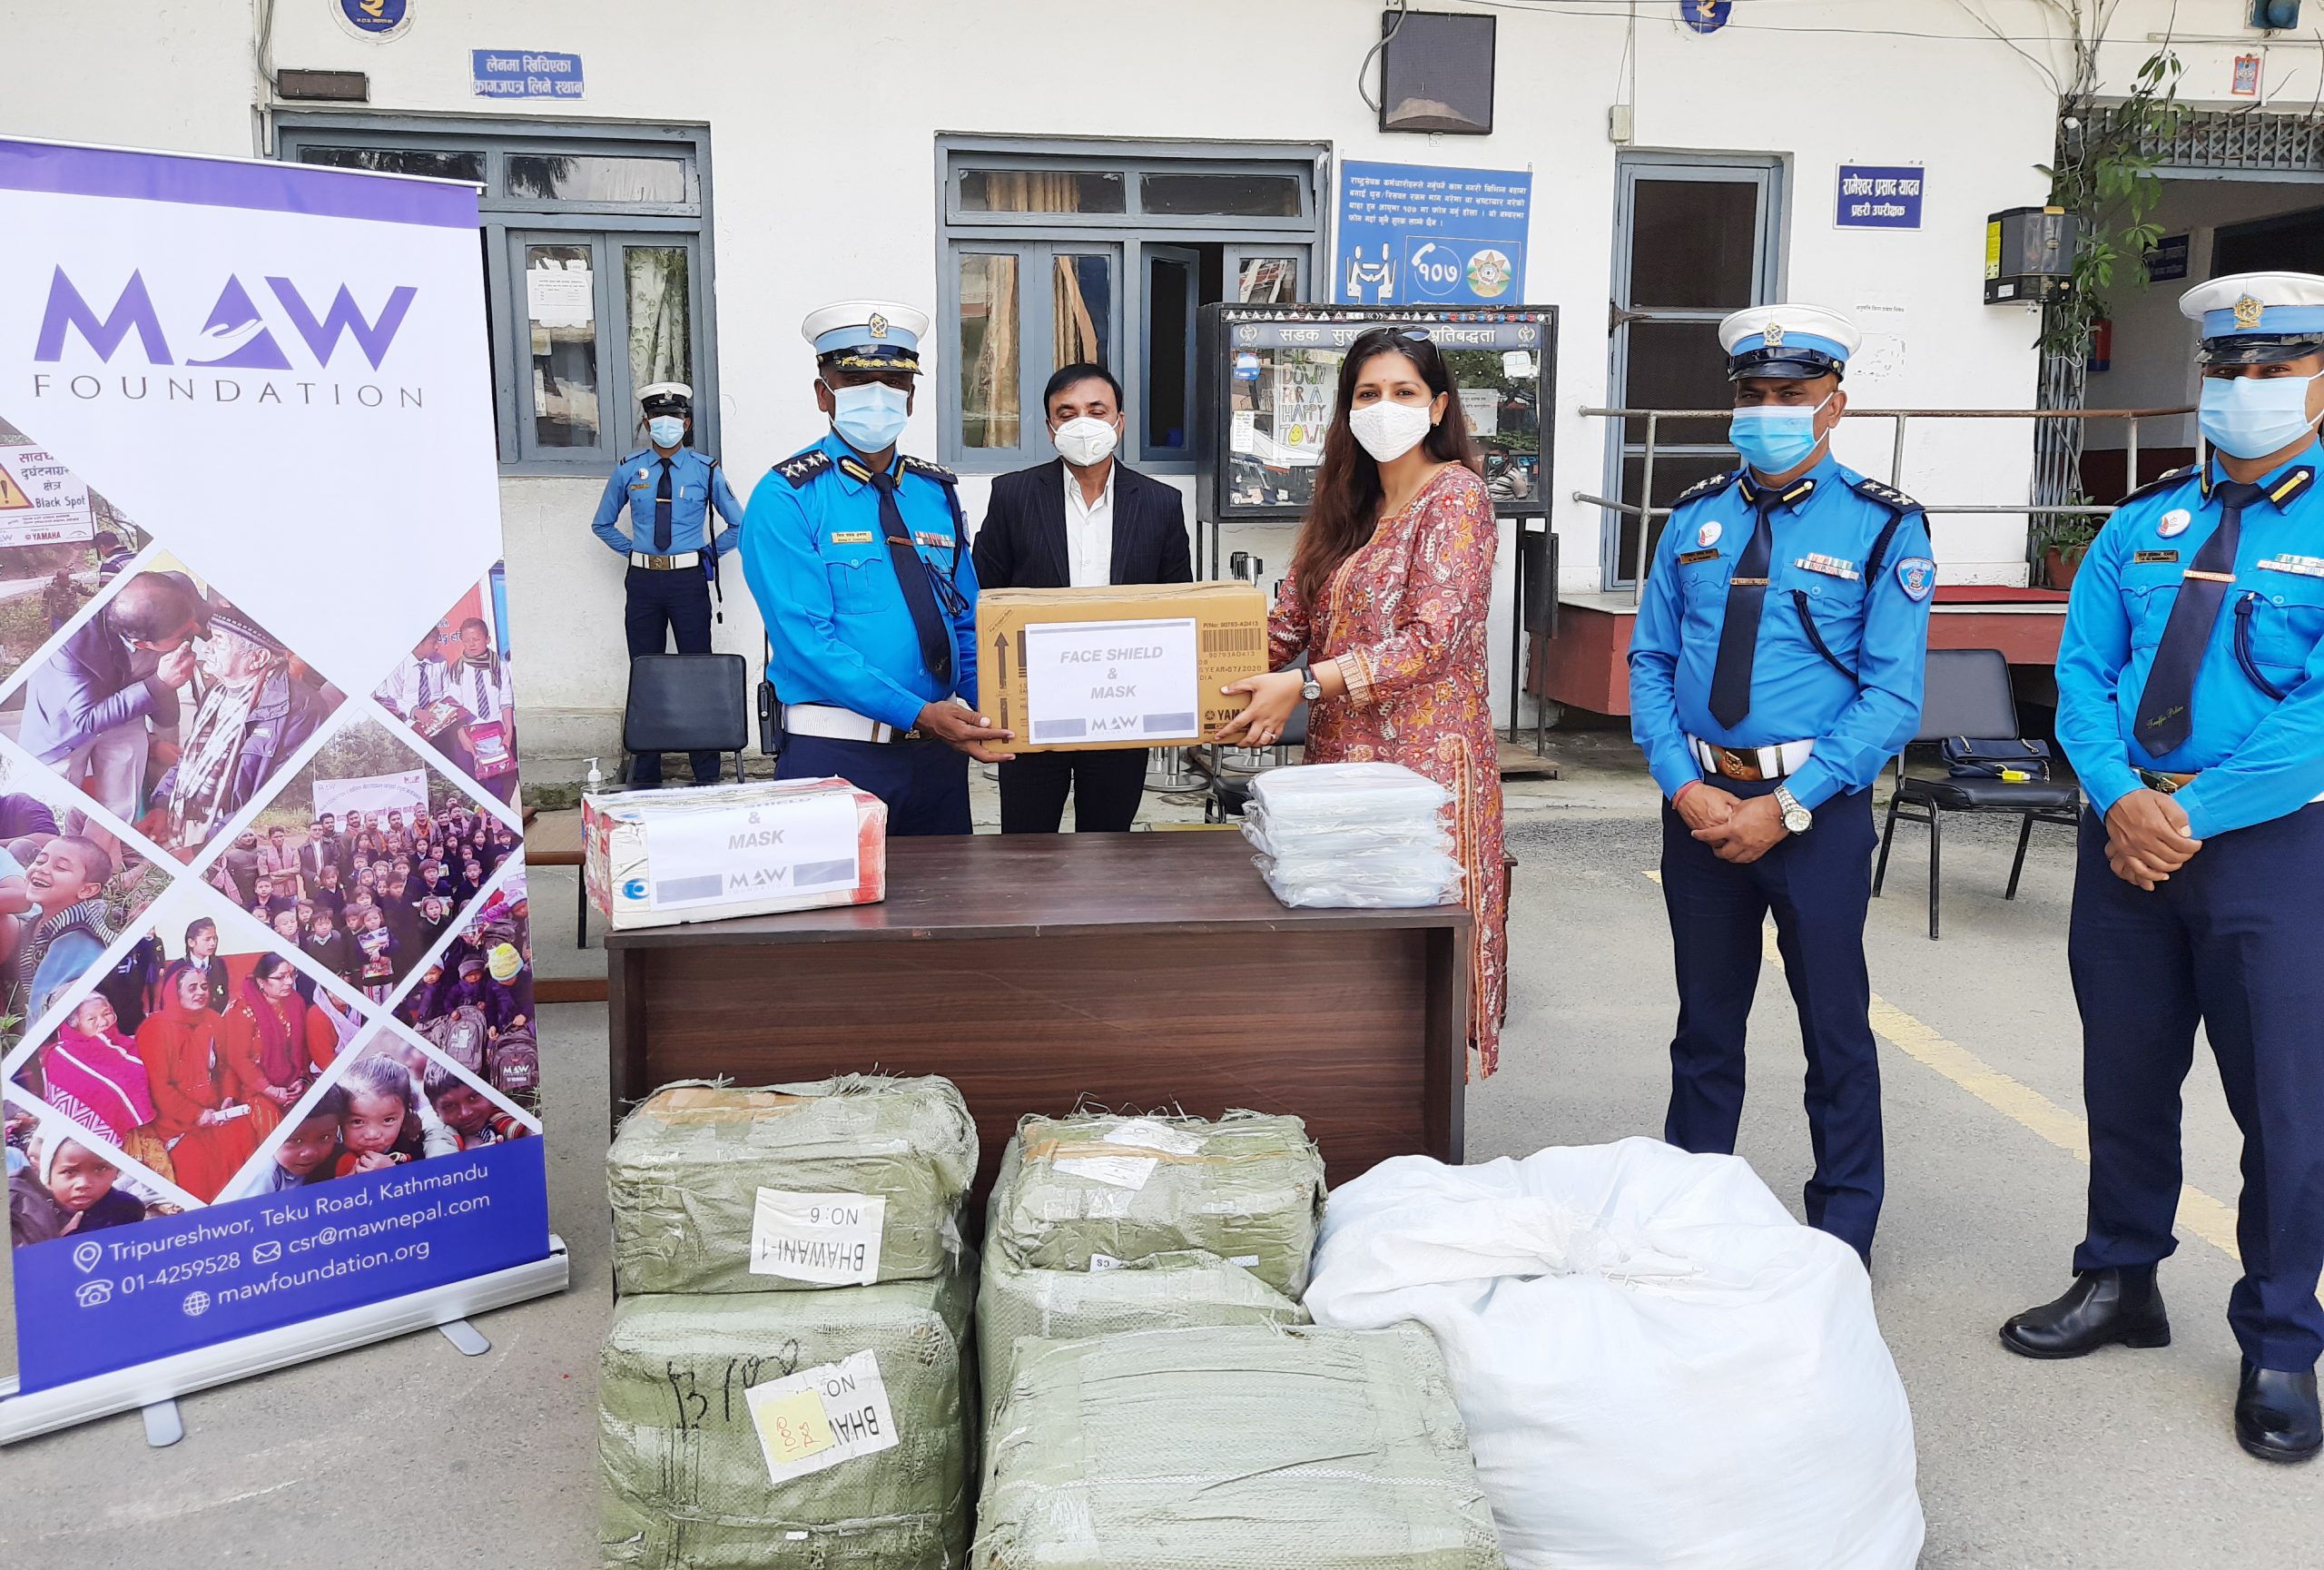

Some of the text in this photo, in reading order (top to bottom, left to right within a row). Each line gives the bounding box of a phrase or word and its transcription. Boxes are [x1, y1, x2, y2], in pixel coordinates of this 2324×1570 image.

[487, 55, 571, 74] लेनमा खिचिएका
[474, 77, 583, 94] कागजपत्र लिने स्थान
[1843, 173, 1920, 197] रामेश्वर प्रसाद यादव
[1851, 202, 1905, 217] प्रहरी उपरीक्षक
[1419, 263, 1458, 281] १०७
[34, 263, 419, 372] MAW
[1278, 328, 1320, 342] सडक
[1283, 365, 1325, 385] DOWN
[34, 374, 423, 409] FOUNDATION
[1283, 386, 1322, 403] FOR A
[1282, 404, 1326, 422] HAPPY
[44, 480, 61, 490] क्षेत्र
[35, 495, 85, 509] Black Spot
[33, 531, 61, 540] YAMAHA
[1060, 646, 1163, 664] FACE SHIELD
[1108, 667, 1118, 679] &
[1090, 685, 1137, 699] MASK
[1091, 715, 1137, 731] MAW
[1217, 708, 1246, 720] YAM
[748, 811, 761, 824] &
[728, 829, 785, 850] MASK
[730, 866, 787, 889] MAW
[503, 1064, 530, 1073] MAW
[108, 1163, 488, 1265] Tripureshwor, Teku Road, Kathmandu
[121, 1192, 490, 1295] 01-4259528 csr@mawnepal.com
[762, 1237, 865, 1271] BHAWANI-1
[218, 1240, 430, 1305] mawfoundation.org
